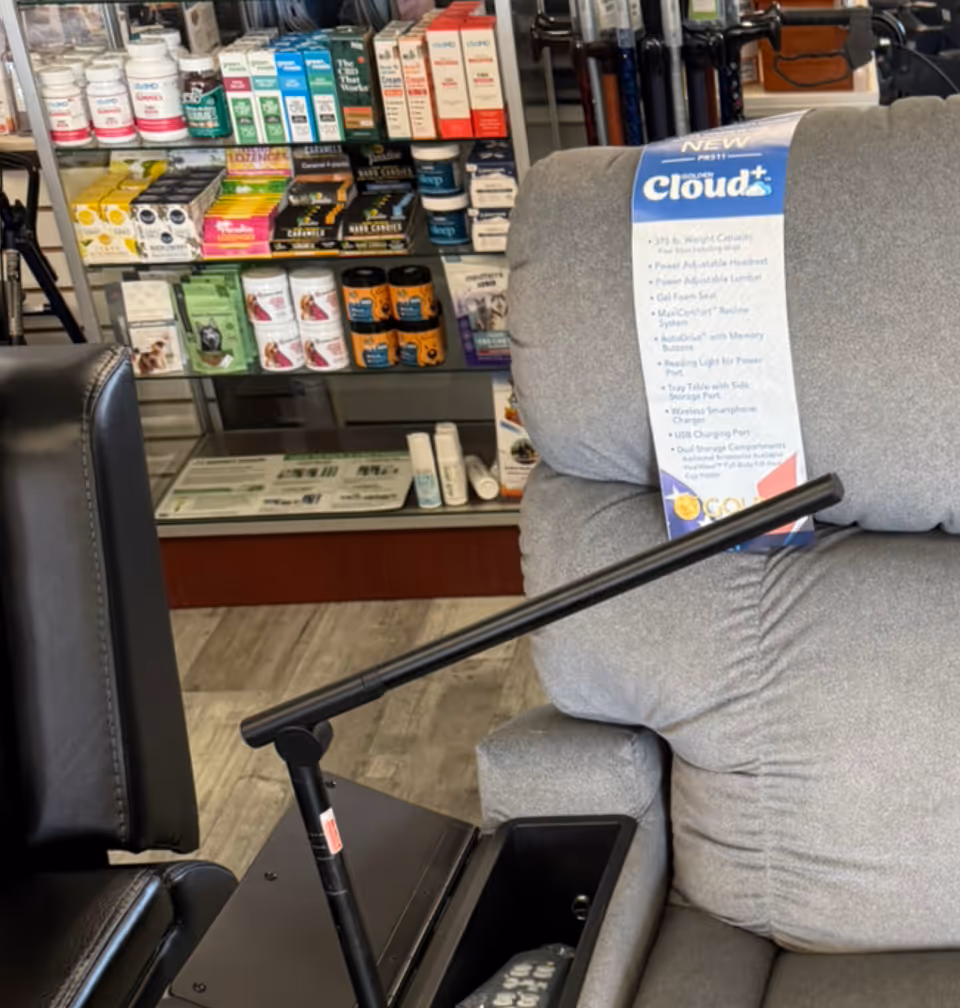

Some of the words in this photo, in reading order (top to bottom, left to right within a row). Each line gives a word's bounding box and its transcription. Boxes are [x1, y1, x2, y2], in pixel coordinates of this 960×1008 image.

[341, 84, 370, 92] Works
[681, 137, 752, 153] NEW
[685, 234, 714, 246] Weight
[716, 232, 753, 244] Capacity
[655, 261, 680, 270] Power
[682, 258, 728, 271] Adjustable
[730, 256, 768, 266] Headrest
[655, 277, 682, 287] Power
[684, 274, 728, 287] Adjustable
[730, 273, 763, 284] Lumbar
[656, 291, 671, 302] Gel
[673, 292, 698, 301] Foam
[698, 291, 716, 300] Seat
[719, 305, 750, 314] Recline
[658, 319, 689, 330] System
[728, 330, 764, 342] Memory
[662, 343, 694, 352] Buttons
[664, 359, 698, 369] Reading
[699, 356, 720, 369] Light
[736, 354, 763, 365] Power
[666, 368, 684, 377] Port
[668, 382, 686, 393] Tray
[687, 382, 710, 391] Table
[731, 380, 750, 389] Side
[669, 392, 702, 403] Storage
[702, 391, 721, 400] Port
[671, 406, 705, 416] Wireless
[706, 404, 757, 417] Smartphone
[672, 416, 705, 426] Charger
[674, 430, 693, 439] USB
[693, 428, 731, 441] Charging
[732, 426, 752, 437] Port
[677, 444, 695, 454] Dual
[696, 444, 726, 455] Storage
[728, 442, 786, 453] Compartments
